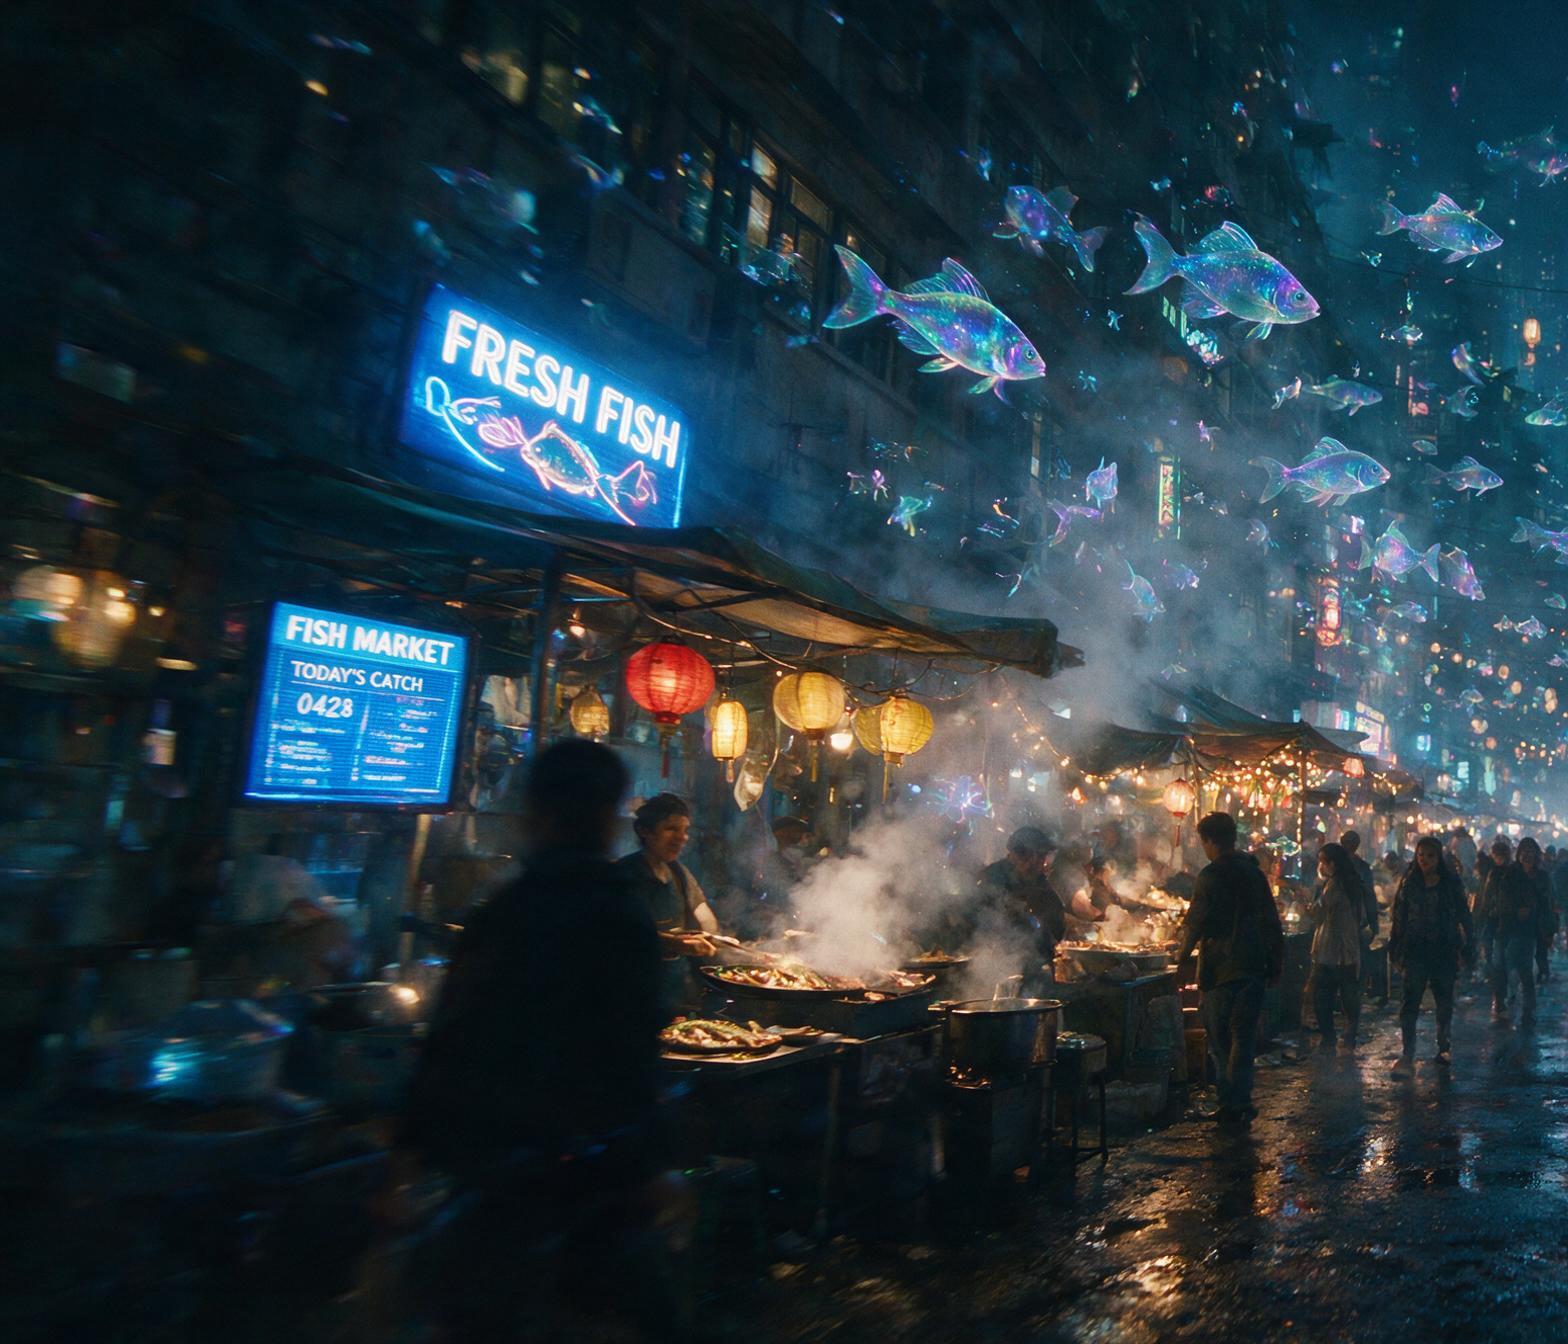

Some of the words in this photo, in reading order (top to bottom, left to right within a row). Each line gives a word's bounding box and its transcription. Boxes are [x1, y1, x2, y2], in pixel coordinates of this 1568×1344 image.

[441, 309, 591, 424] FRESH
[595, 385, 681, 468] FISH
[285, 614, 348, 649] FISH
[352, 625, 455, 665] MARKET
[290, 659, 366, 686] TODAY'S
[369, 671, 424, 693] CATCH
[296, 692, 354, 718] 0428
